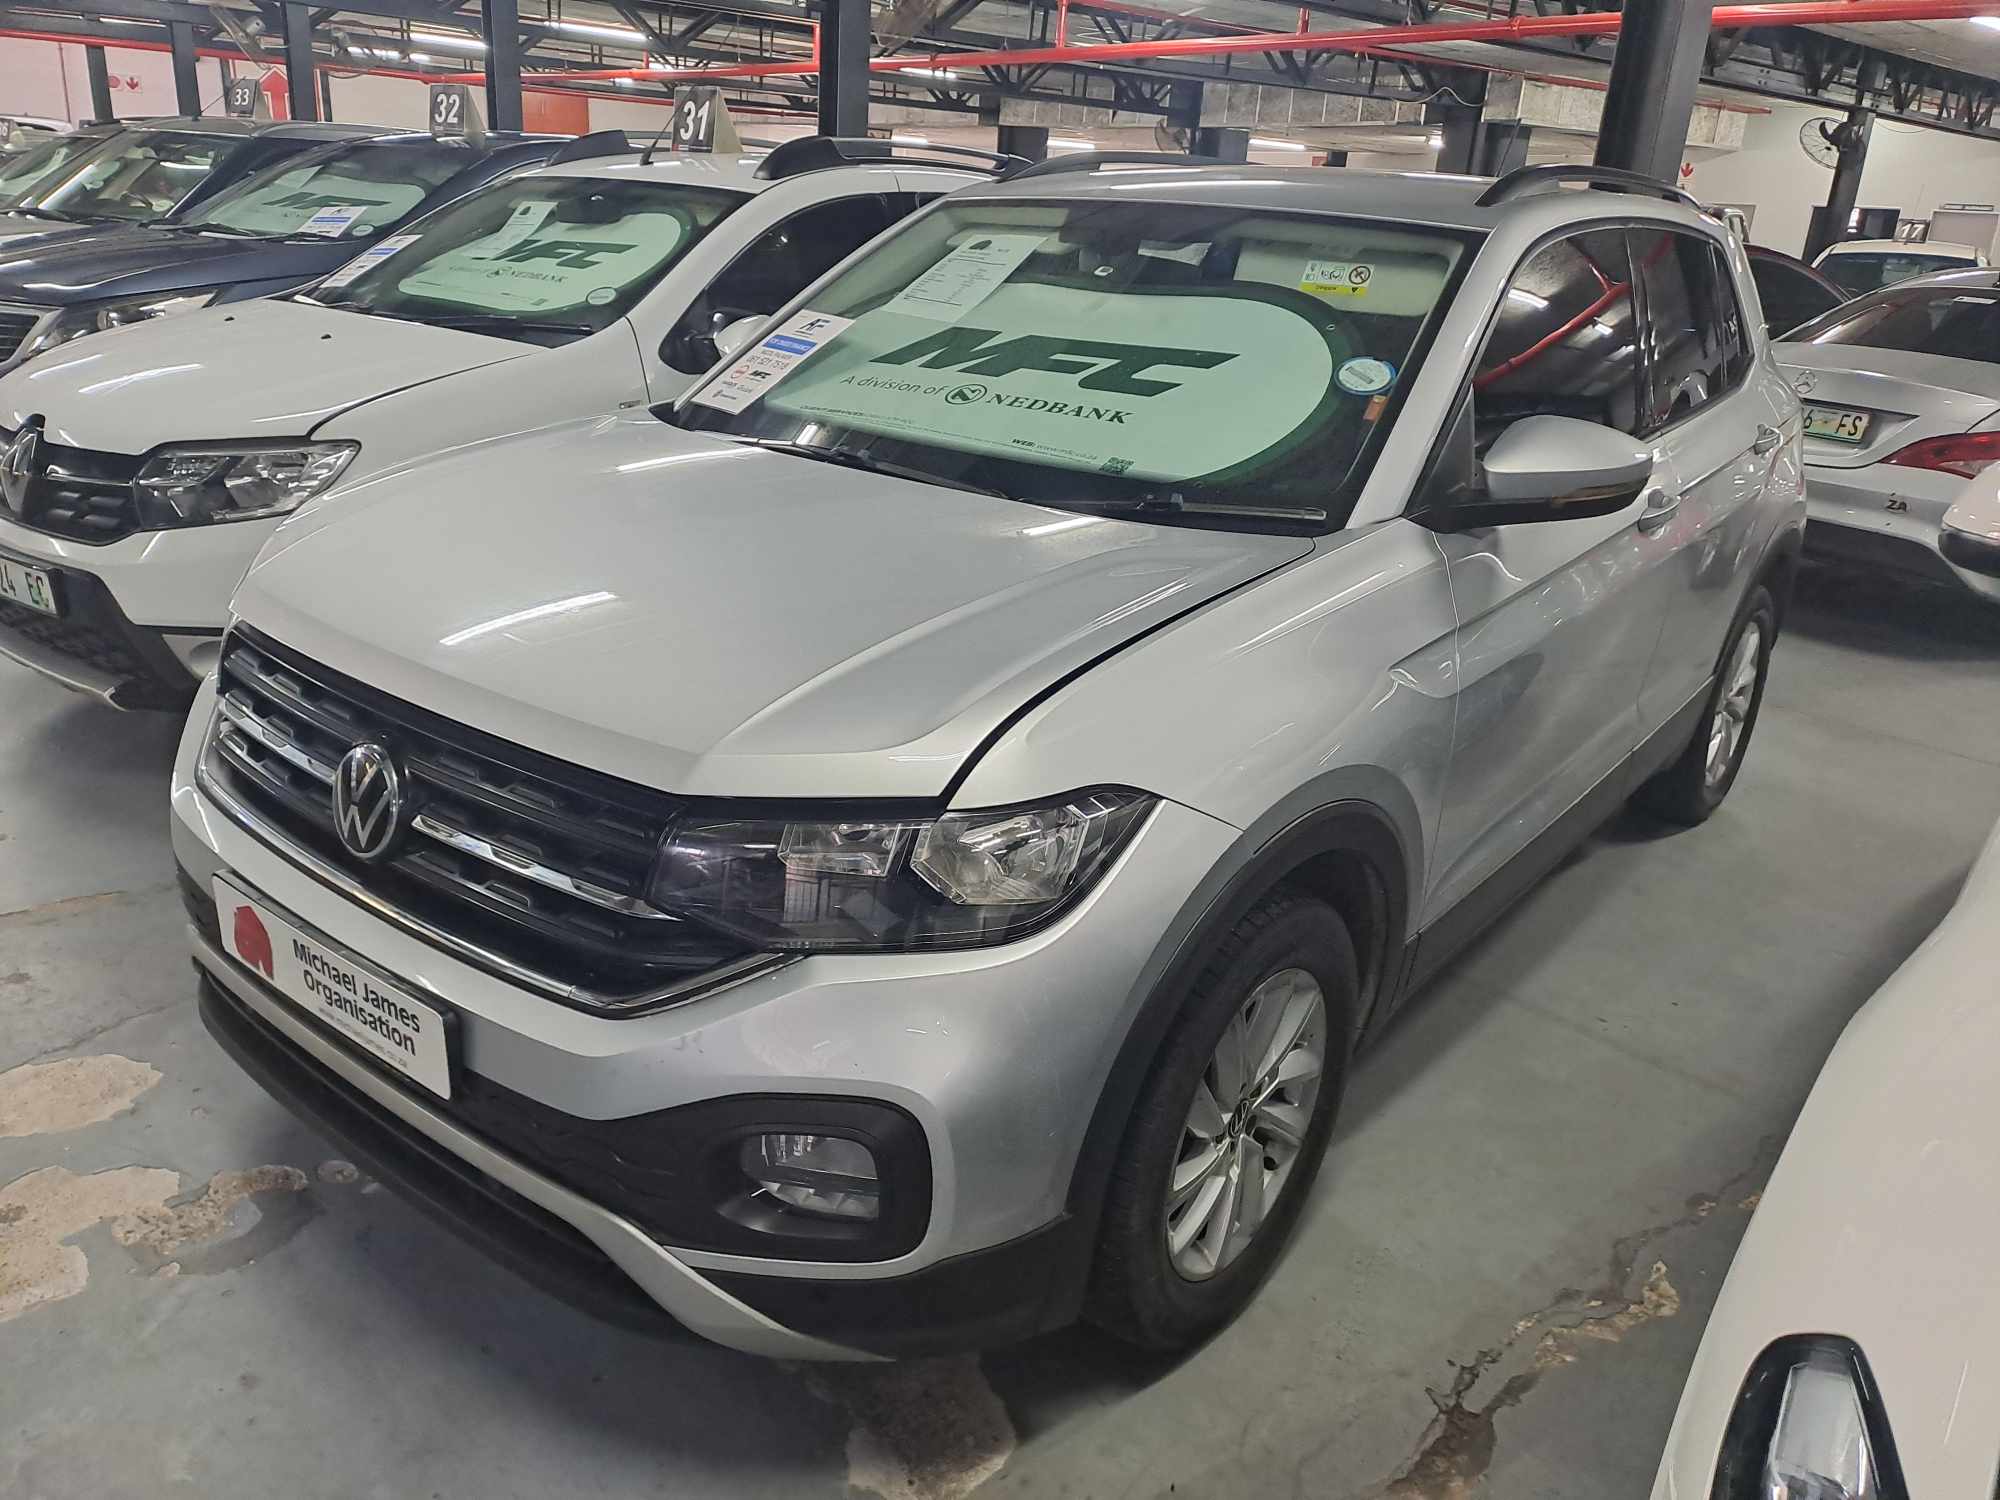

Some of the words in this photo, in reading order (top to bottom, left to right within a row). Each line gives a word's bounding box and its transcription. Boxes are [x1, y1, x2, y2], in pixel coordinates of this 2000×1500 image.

[233, 88, 250, 106] 33
[434, 93, 460, 124] 32
[679, 100, 710, 140] 31
[1900, 223, 1925, 239] 17
[868, 325, 1241, 398] MFC
[840, 375, 855, 386] A
[856, 376, 920, 393] division
[922, 384, 948, 396] of
[986, 392, 1136, 425] NEDBANK
[1834, 414, 1863, 437] FS
[1885, 499, 1908, 513] ZA
[24, 571, 50, 609] EC
[292, 938, 358, 996] Michael
[362, 982, 421, 1034] James
[303, 968, 417, 1056] Organisation
